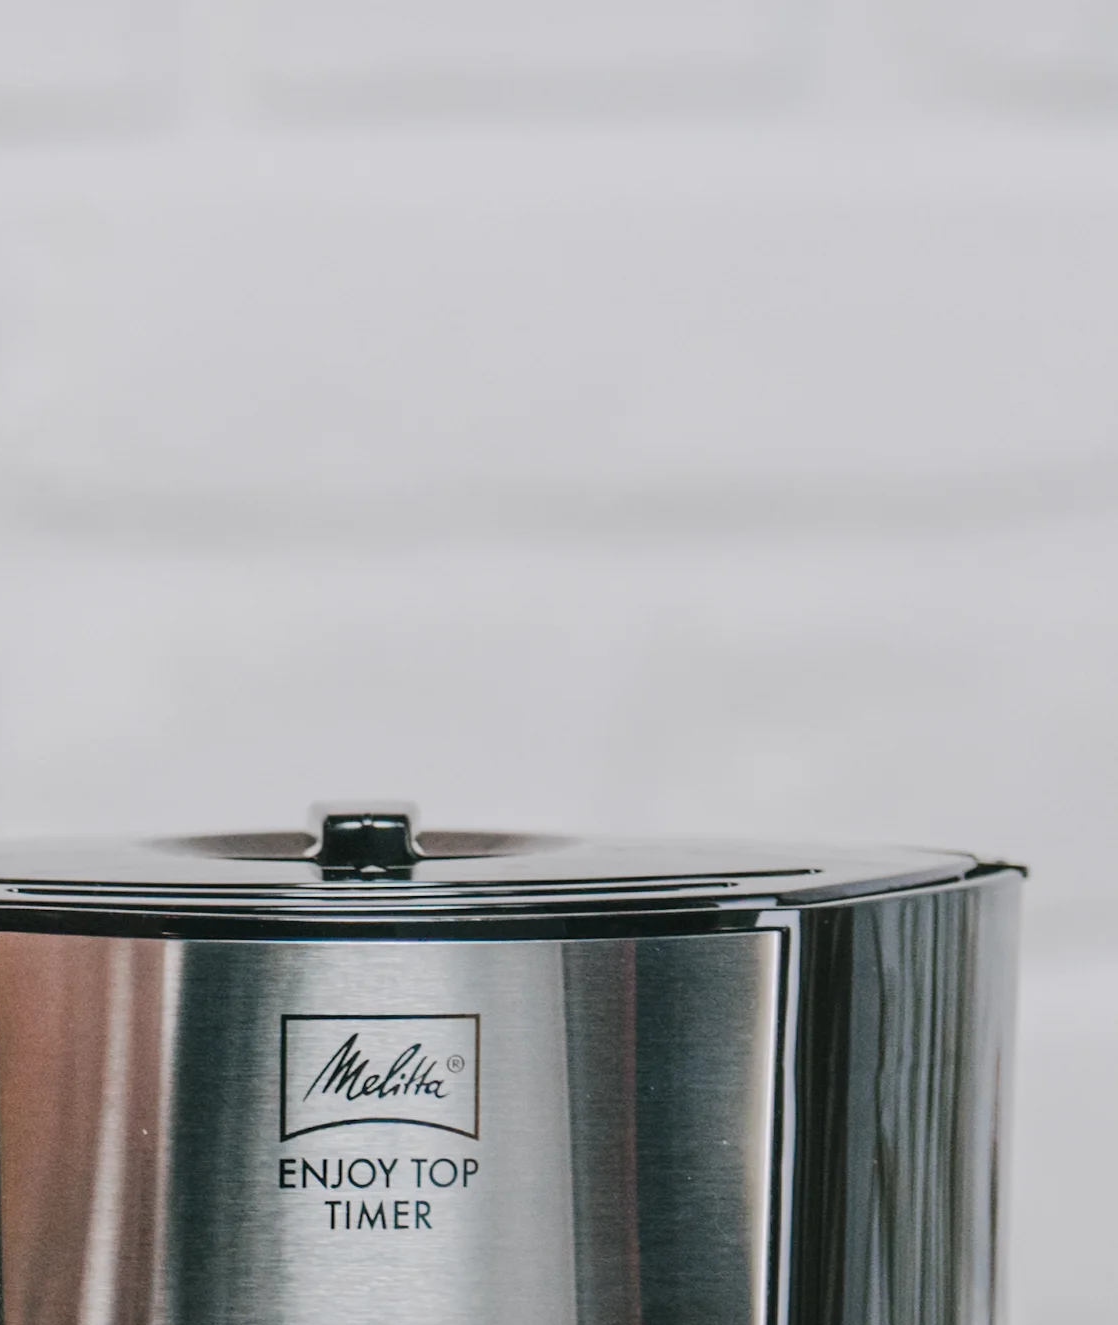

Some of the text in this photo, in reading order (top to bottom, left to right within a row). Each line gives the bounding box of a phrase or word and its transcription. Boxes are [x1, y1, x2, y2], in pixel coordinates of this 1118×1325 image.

[279, 1158, 479, 1189] ENJOY TOP
[325, 1200, 433, 1230] TIMER
